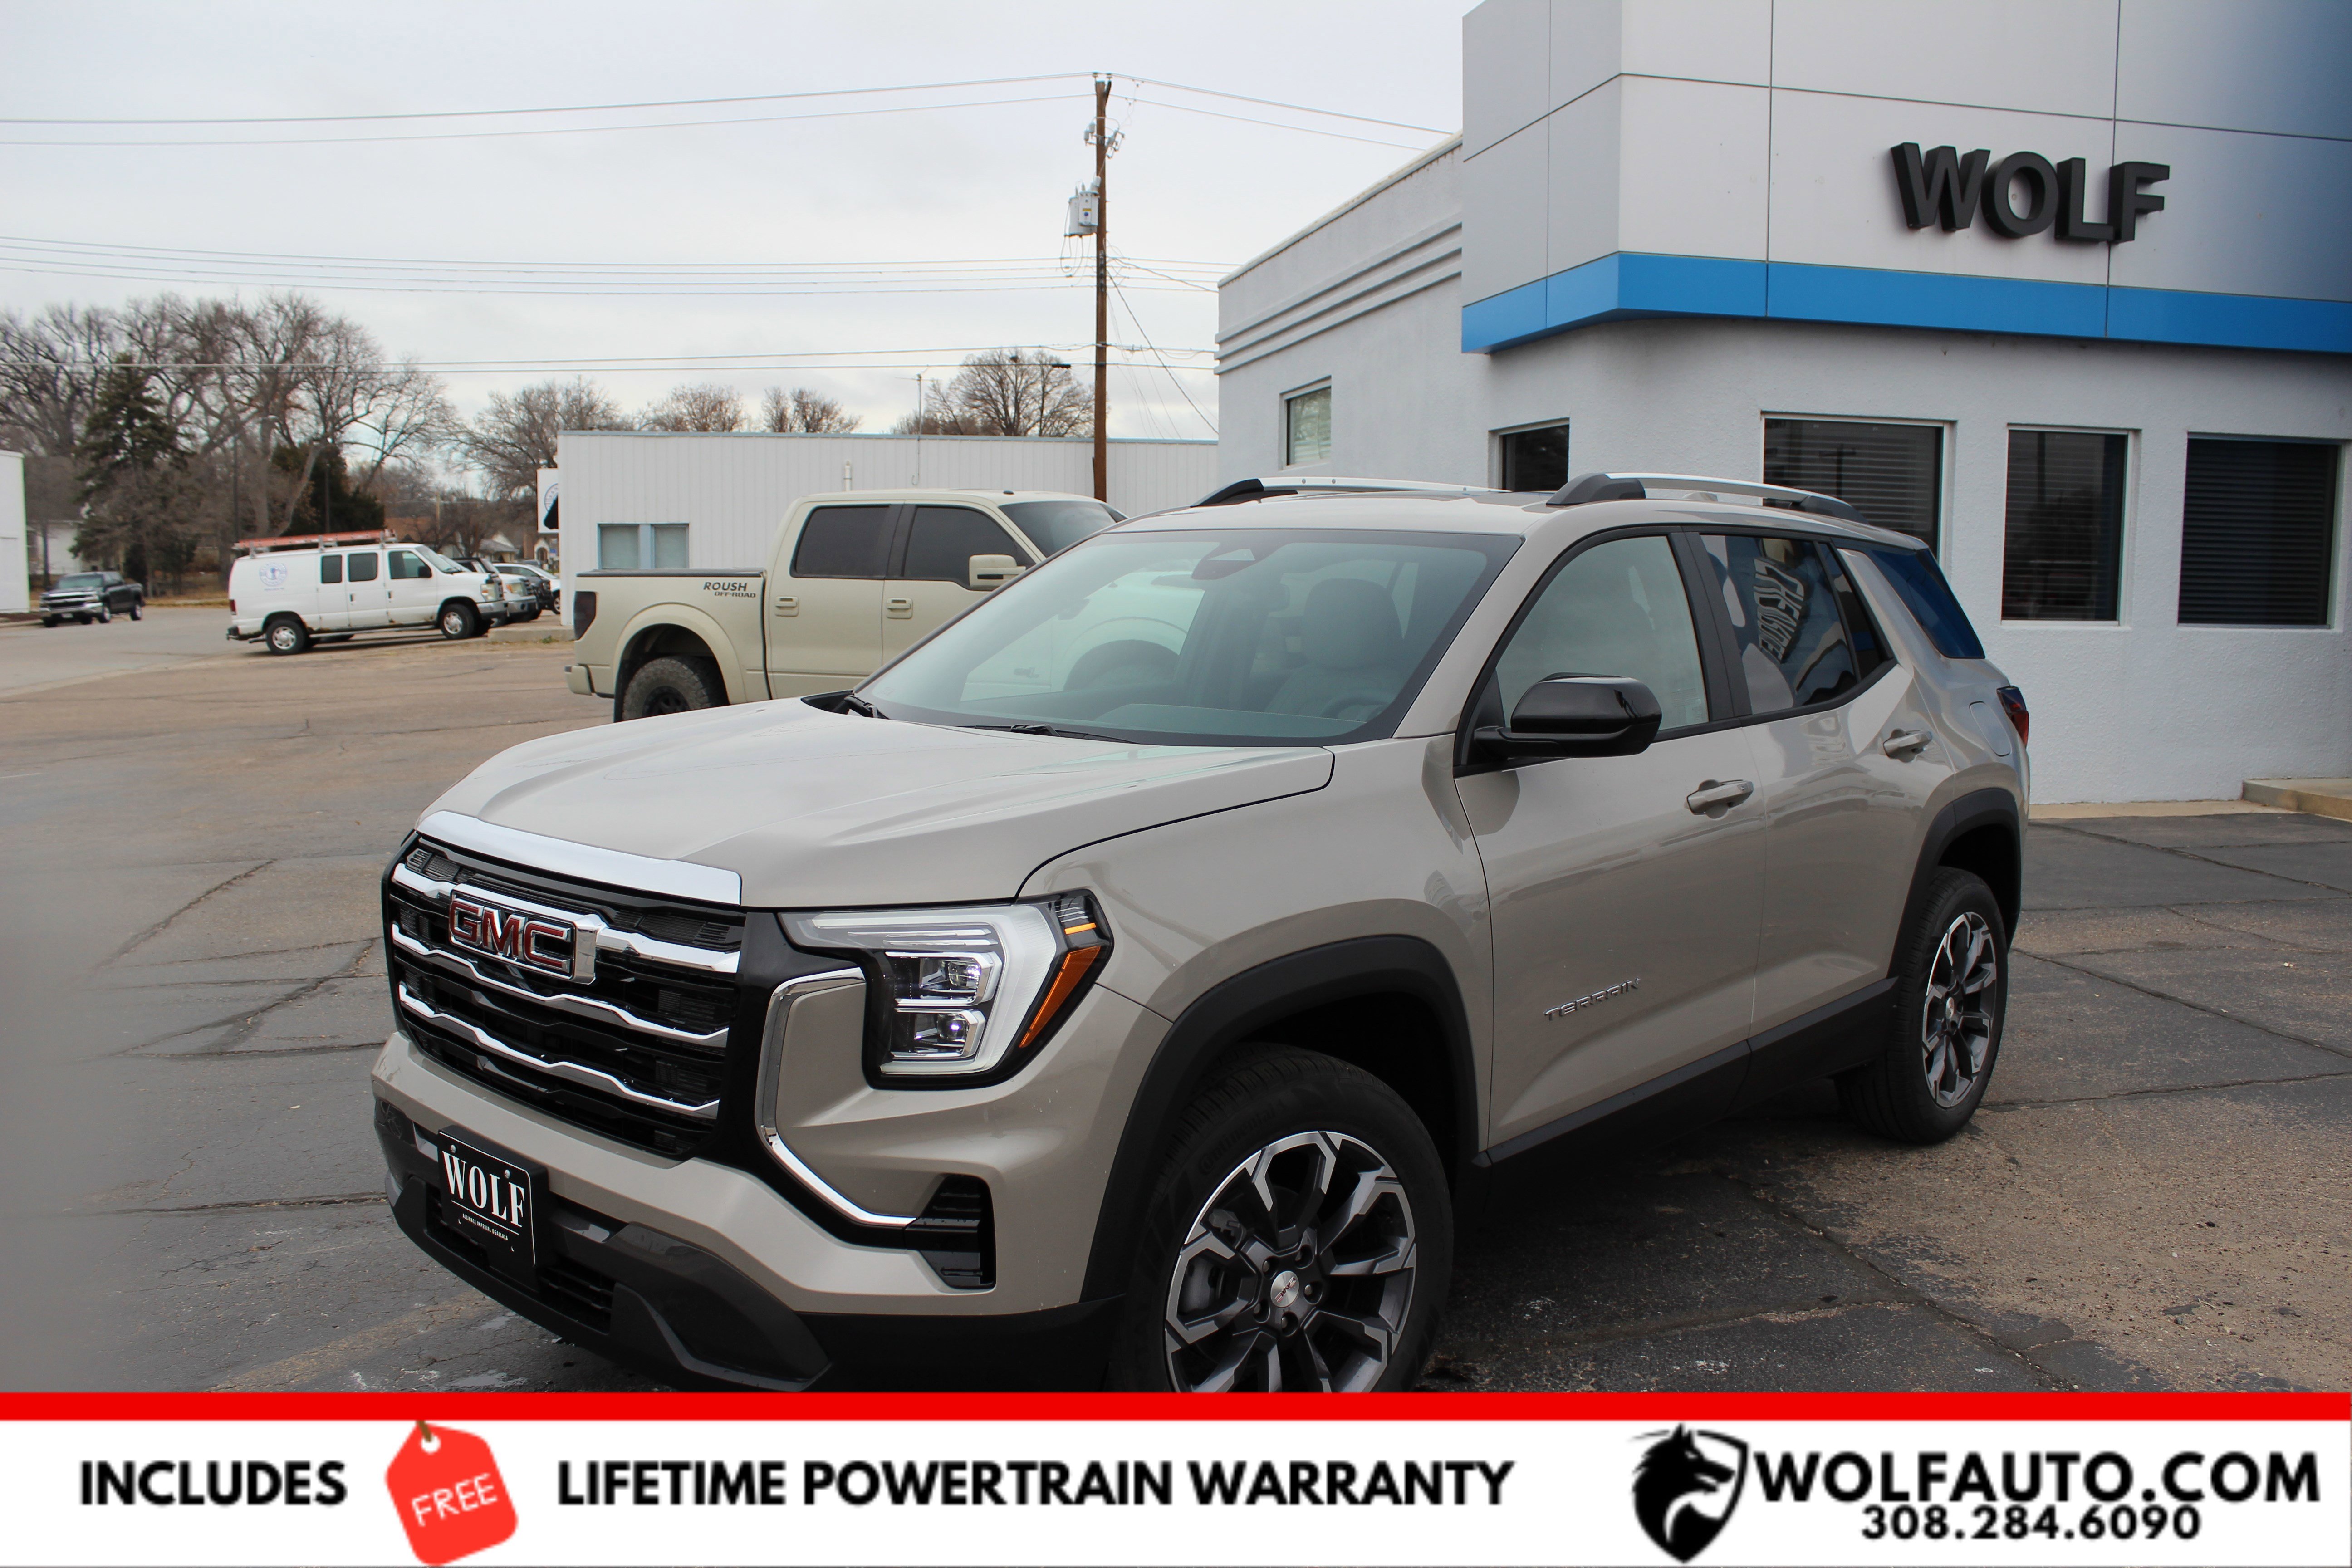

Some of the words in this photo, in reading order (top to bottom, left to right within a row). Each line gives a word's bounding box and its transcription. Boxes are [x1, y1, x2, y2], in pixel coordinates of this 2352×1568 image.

[1891, 142, 2170, 243] WOLF
[704, 582, 747, 591] ROUSH
[449, 898, 571, 972] GMC
[442, 1151, 524, 1227] WOLF
[462, 1213, 476, 1225] ALLIANCE
[477, 1221, 491, 1233] IMPERIAL
[1274, 1276, 1296, 1303] GMC
